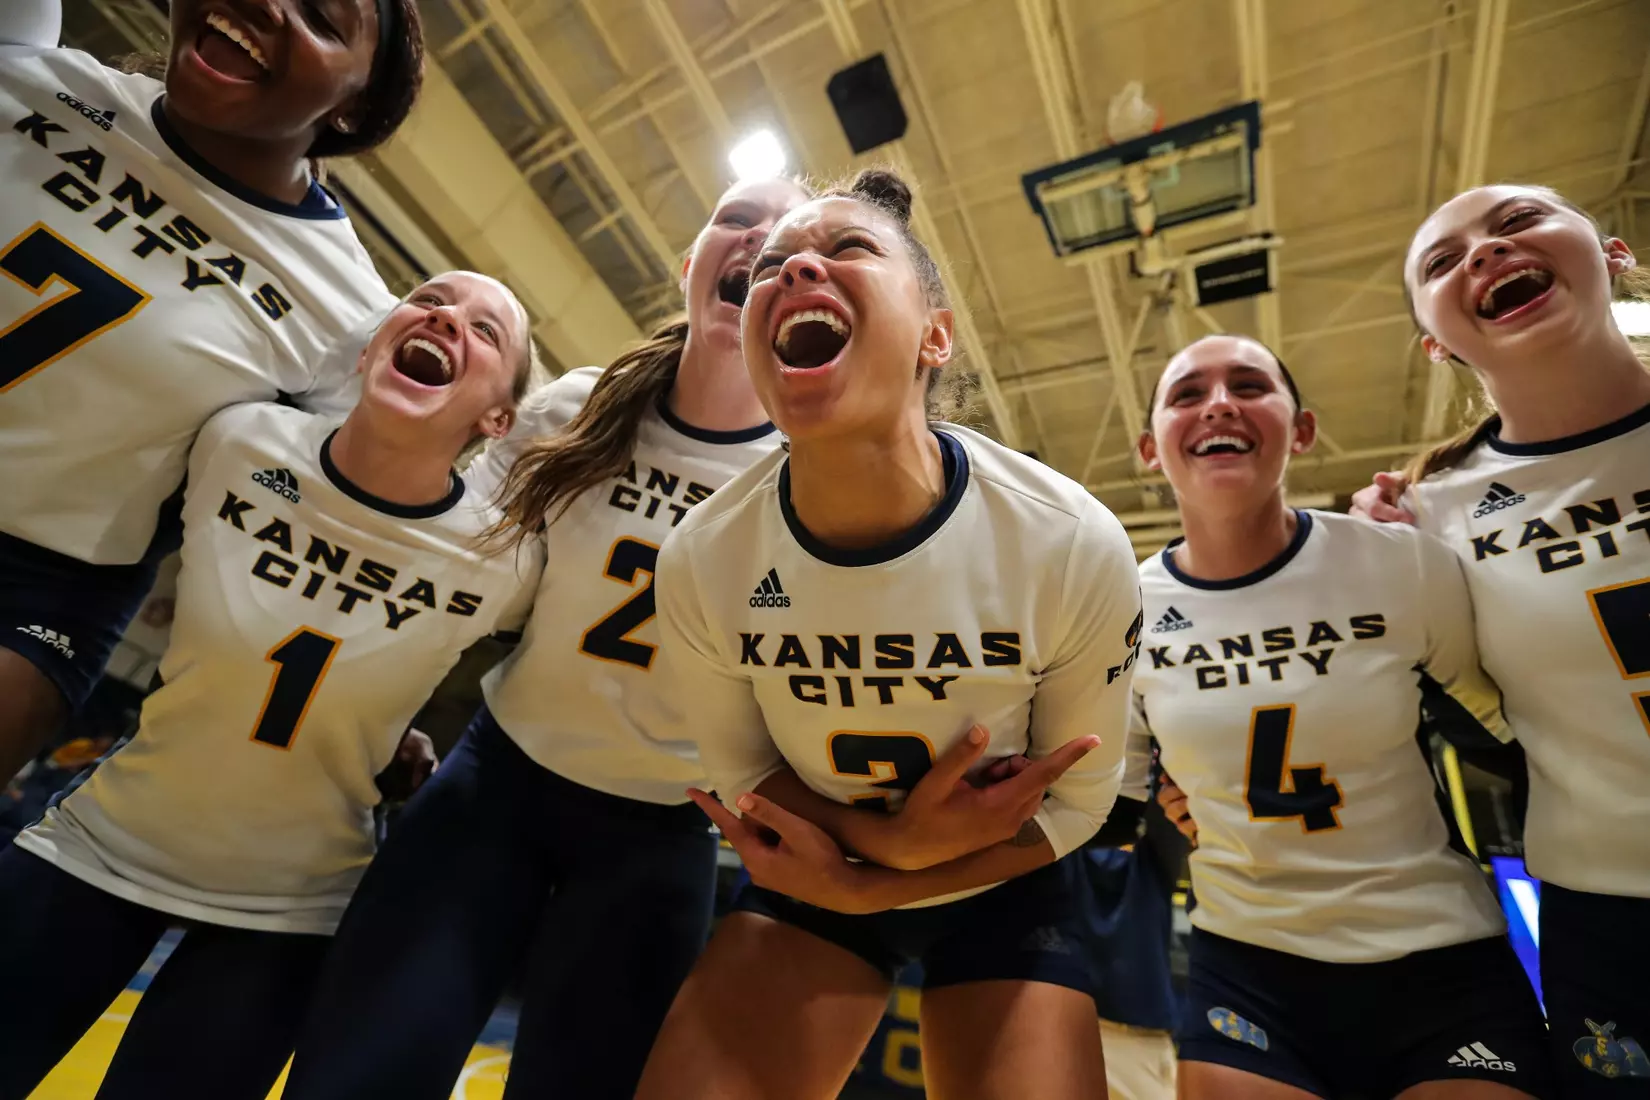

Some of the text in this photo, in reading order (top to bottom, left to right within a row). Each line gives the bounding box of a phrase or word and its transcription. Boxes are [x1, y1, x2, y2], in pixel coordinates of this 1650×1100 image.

[56, 92, 113, 132] adidas
[13, 109, 294, 322] KANSAS
[41, 170, 226, 292] CITY
[0, 220, 154, 394] 7
[251, 472, 301, 504] adidas
[1473, 494, 1526, 518] adidas
[216, 489, 483, 616] KANSAS
[251, 550, 421, 630] CITY
[577, 535, 660, 673] 2
[1147, 613, 1387, 670] KANSAS
[248, 624, 343, 751] 1
[738, 631, 1021, 670] KANSAS
[788, 674, 960, 707] CITY
[1195, 648, 1335, 690] CITY
[1242, 703, 1344, 834] 4
